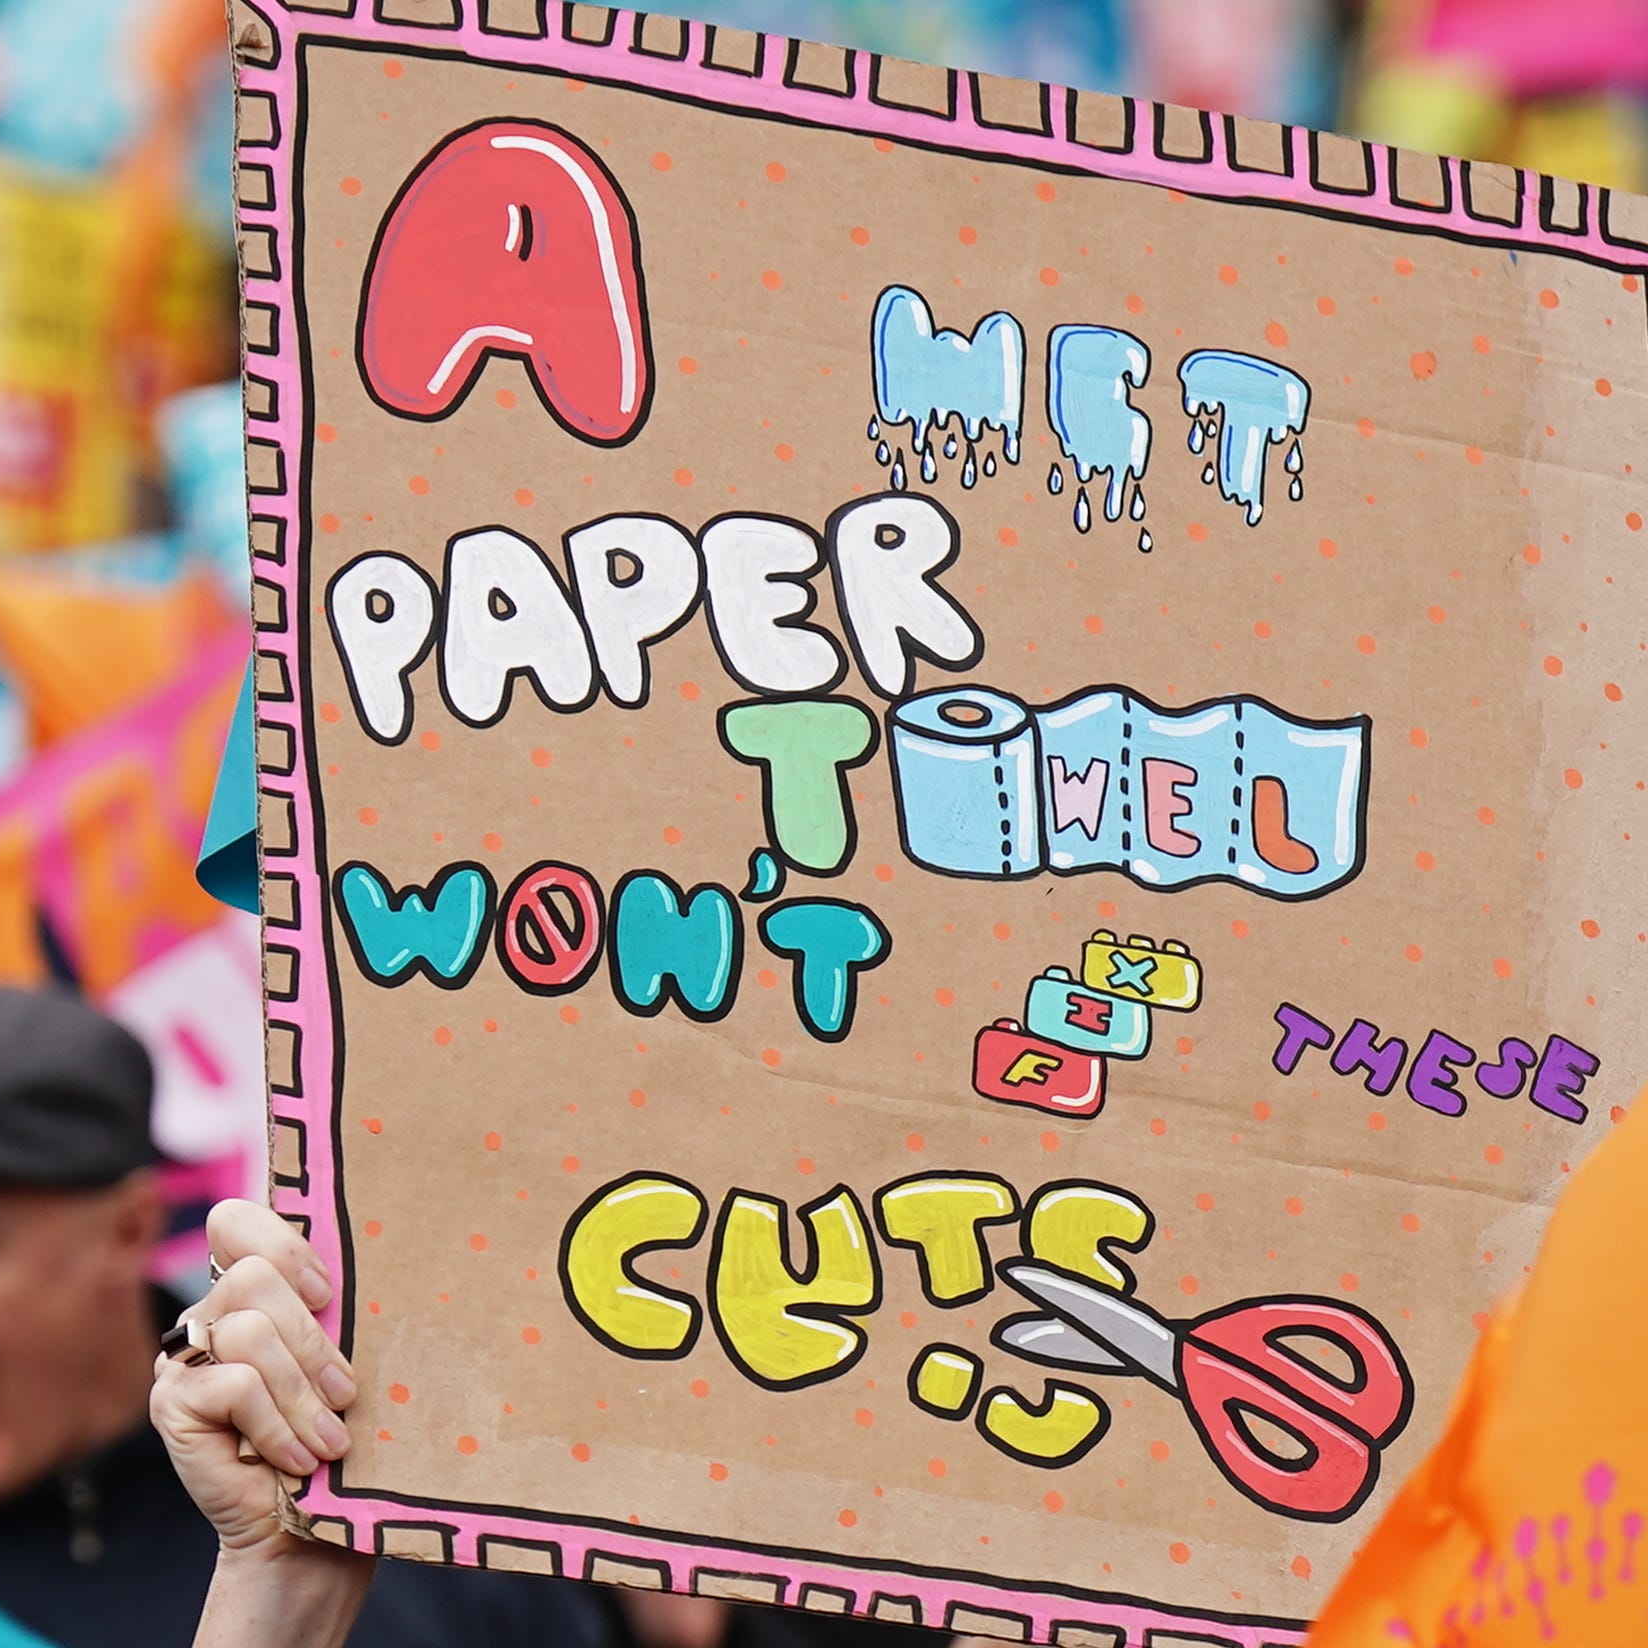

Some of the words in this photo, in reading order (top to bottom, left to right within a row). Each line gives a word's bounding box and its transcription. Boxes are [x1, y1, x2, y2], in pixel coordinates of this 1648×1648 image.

[355, 116, 653, 448] A
[870, 284, 1311, 528] WET
[329, 491, 982, 745] PAPER
[335, 850, 893, 1042] WON'T
[988, 938, 1178, 1102] FIX
[1272, 1001, 1602, 1126] THESE
[558, 1169, 1155, 1468] CUTS
